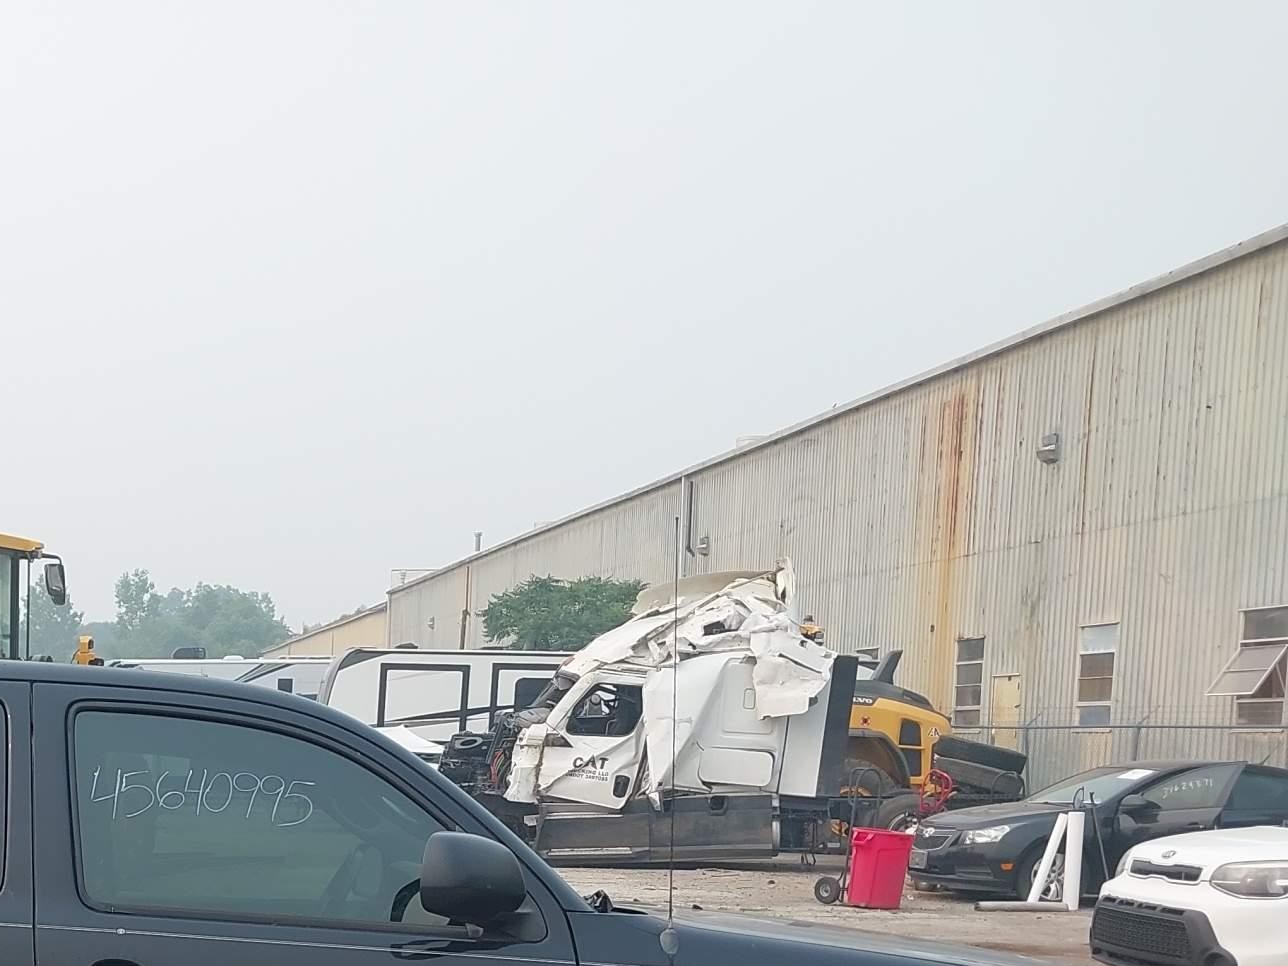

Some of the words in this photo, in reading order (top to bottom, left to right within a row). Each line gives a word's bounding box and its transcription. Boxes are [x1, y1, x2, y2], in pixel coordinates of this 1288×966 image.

[853, 696, 873, 704] LVO
[573, 754, 609, 770] CAT
[90, 765, 316, 827] 45640995
